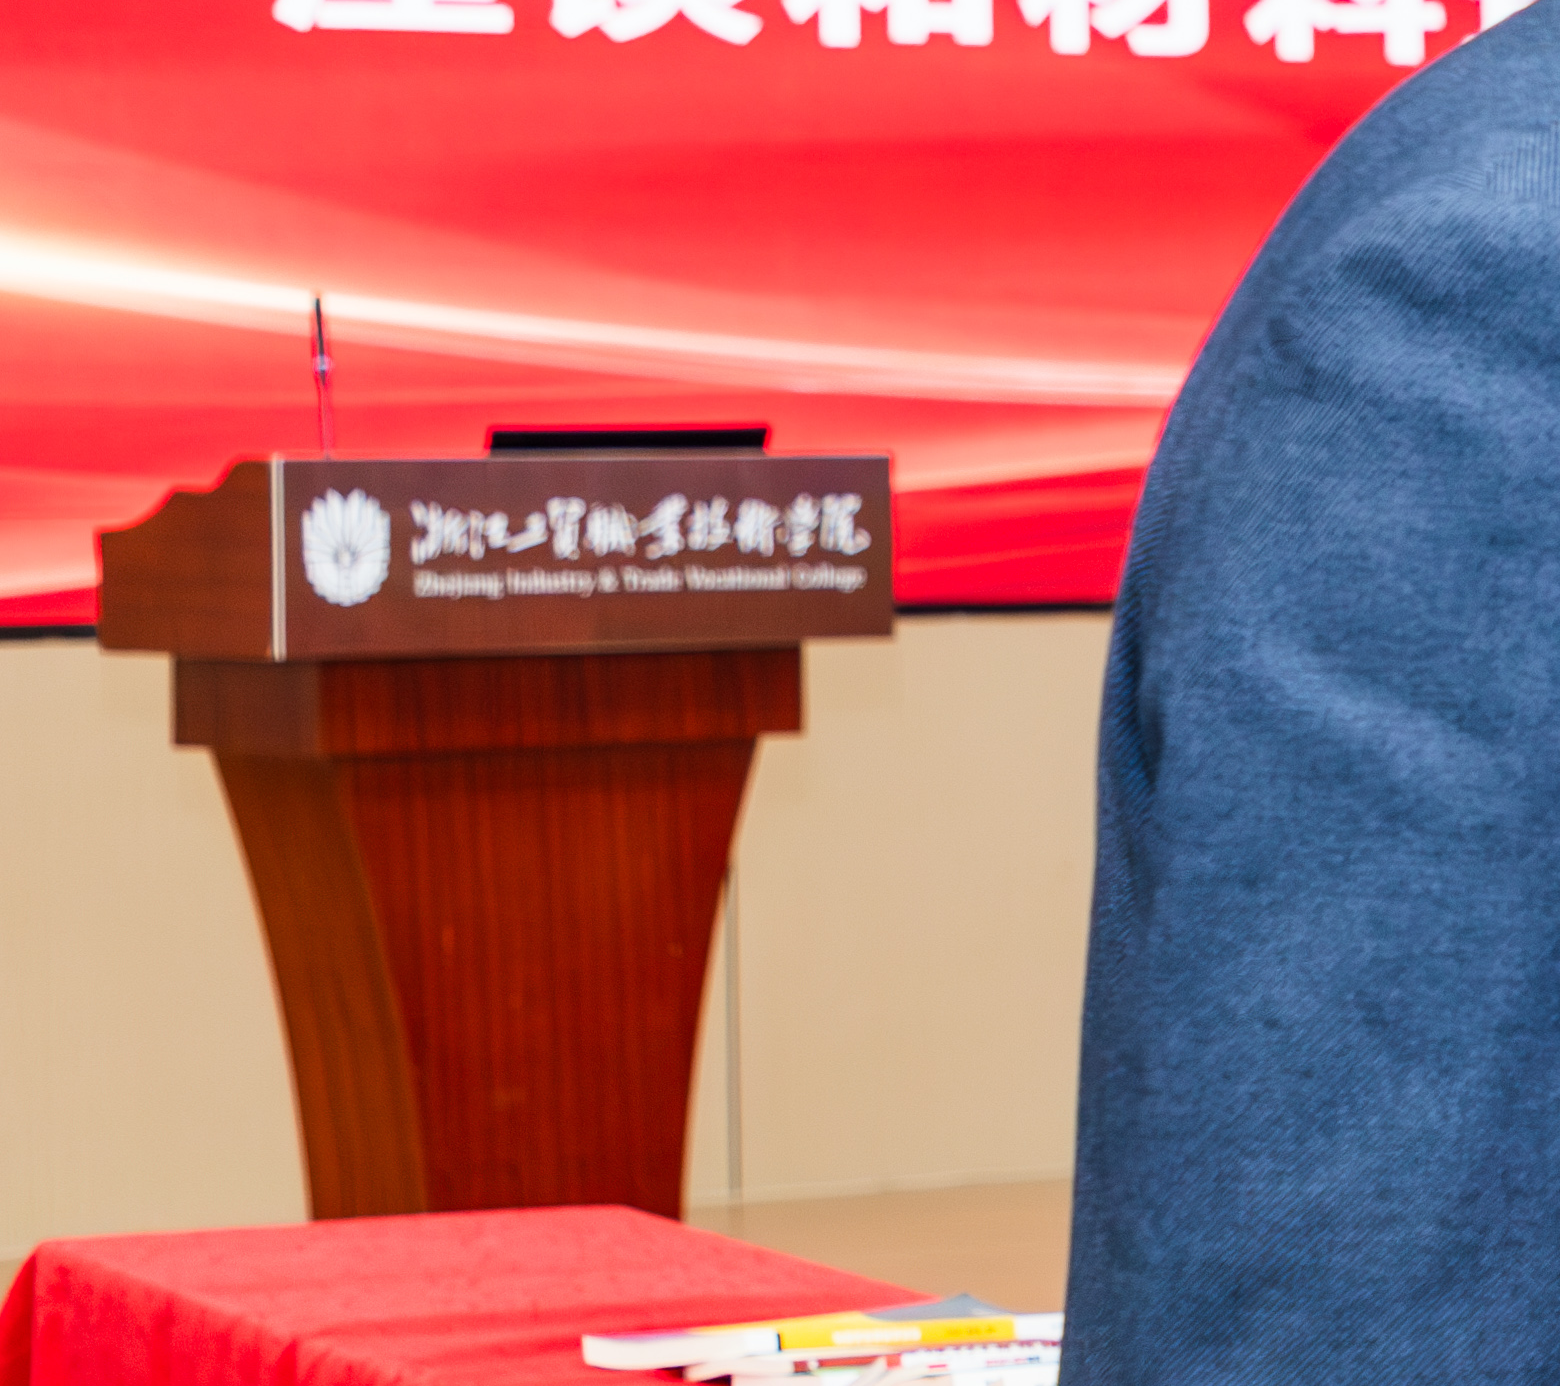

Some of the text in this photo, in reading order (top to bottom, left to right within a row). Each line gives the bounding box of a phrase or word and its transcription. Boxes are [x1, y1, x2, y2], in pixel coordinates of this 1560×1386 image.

[413, 561, 868, 599] Zhejiang Industry & Trade Vocational College
